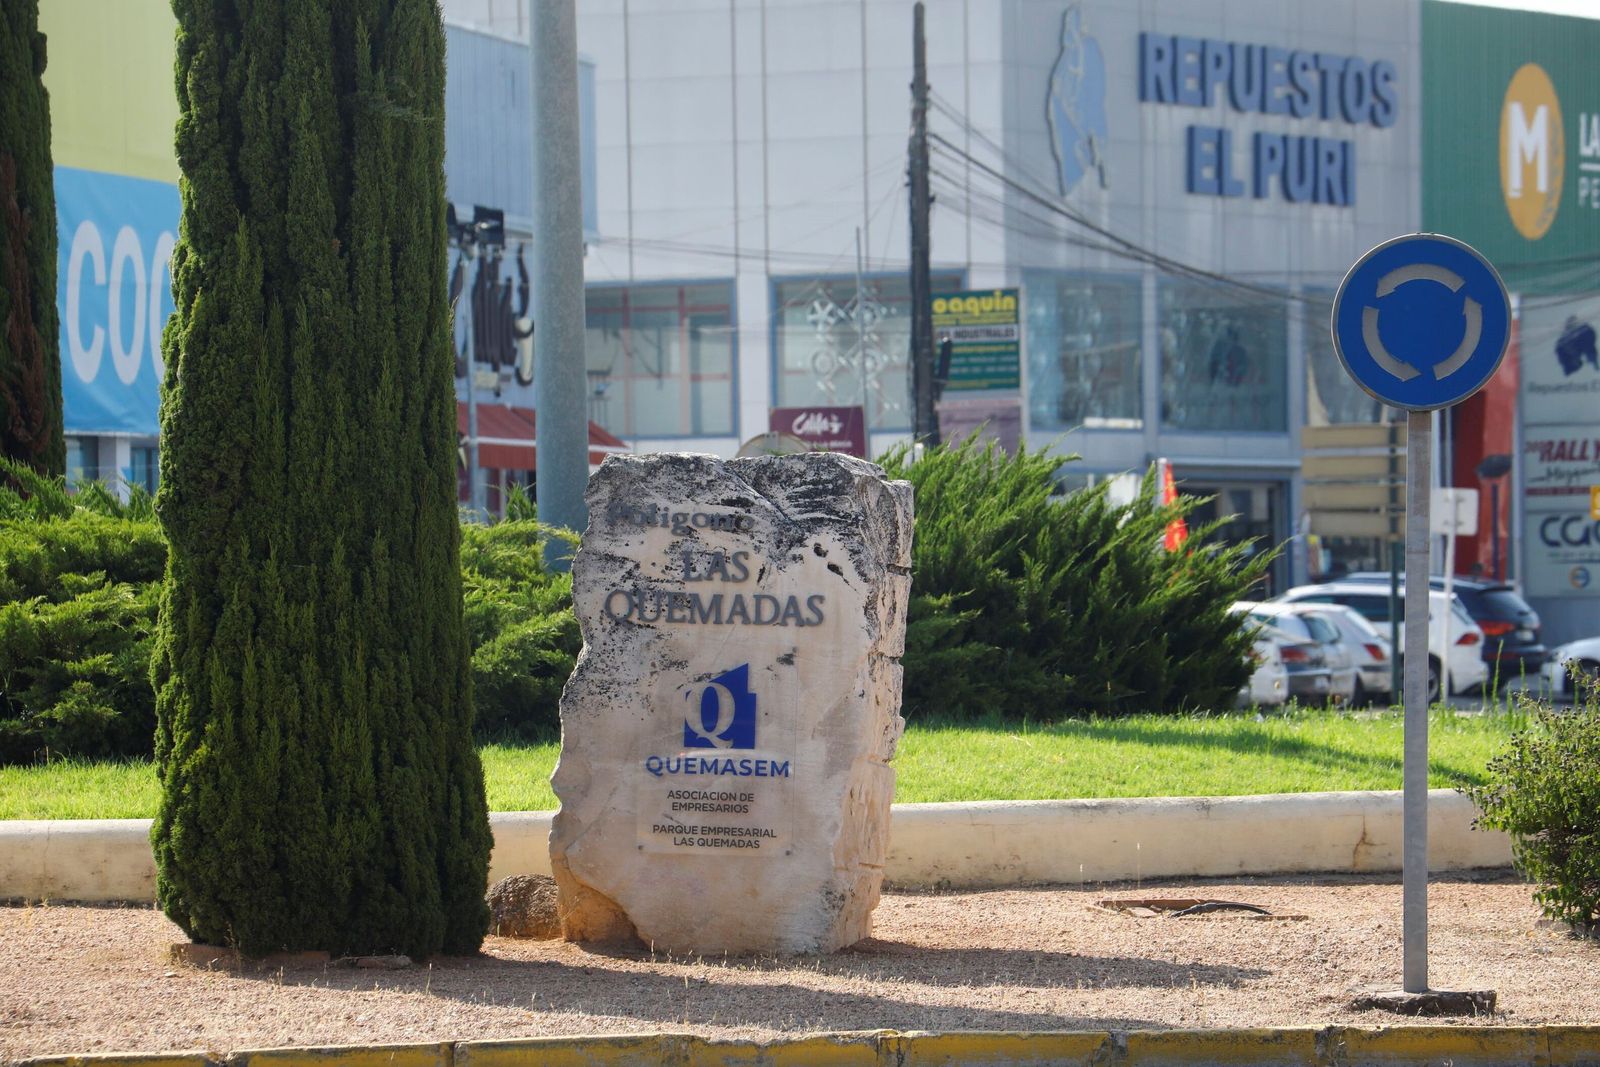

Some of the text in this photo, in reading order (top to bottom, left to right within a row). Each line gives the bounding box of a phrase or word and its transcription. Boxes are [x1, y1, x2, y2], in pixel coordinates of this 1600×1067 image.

[1139, 32, 1398, 128] REPUESTOS
[1509, 101, 1548, 198] M
[1186, 125, 1356, 208] EL PURI
[932, 289, 1015, 316] oaquin
[682, 551, 750, 583] LAS
[603, 589, 826, 627] QUEMADAS
[684, 681, 736, 749] Q
[645, 755, 790, 777] QUEMASEM
[667, 790, 755, 802] ASOCIACION DE
[671, 802, 749, 814] EMPRESARIOS
[652, 825, 777, 838] PARQUE EMPRESARIAL
[673, 837, 760, 849] LAS QUEMADAS
